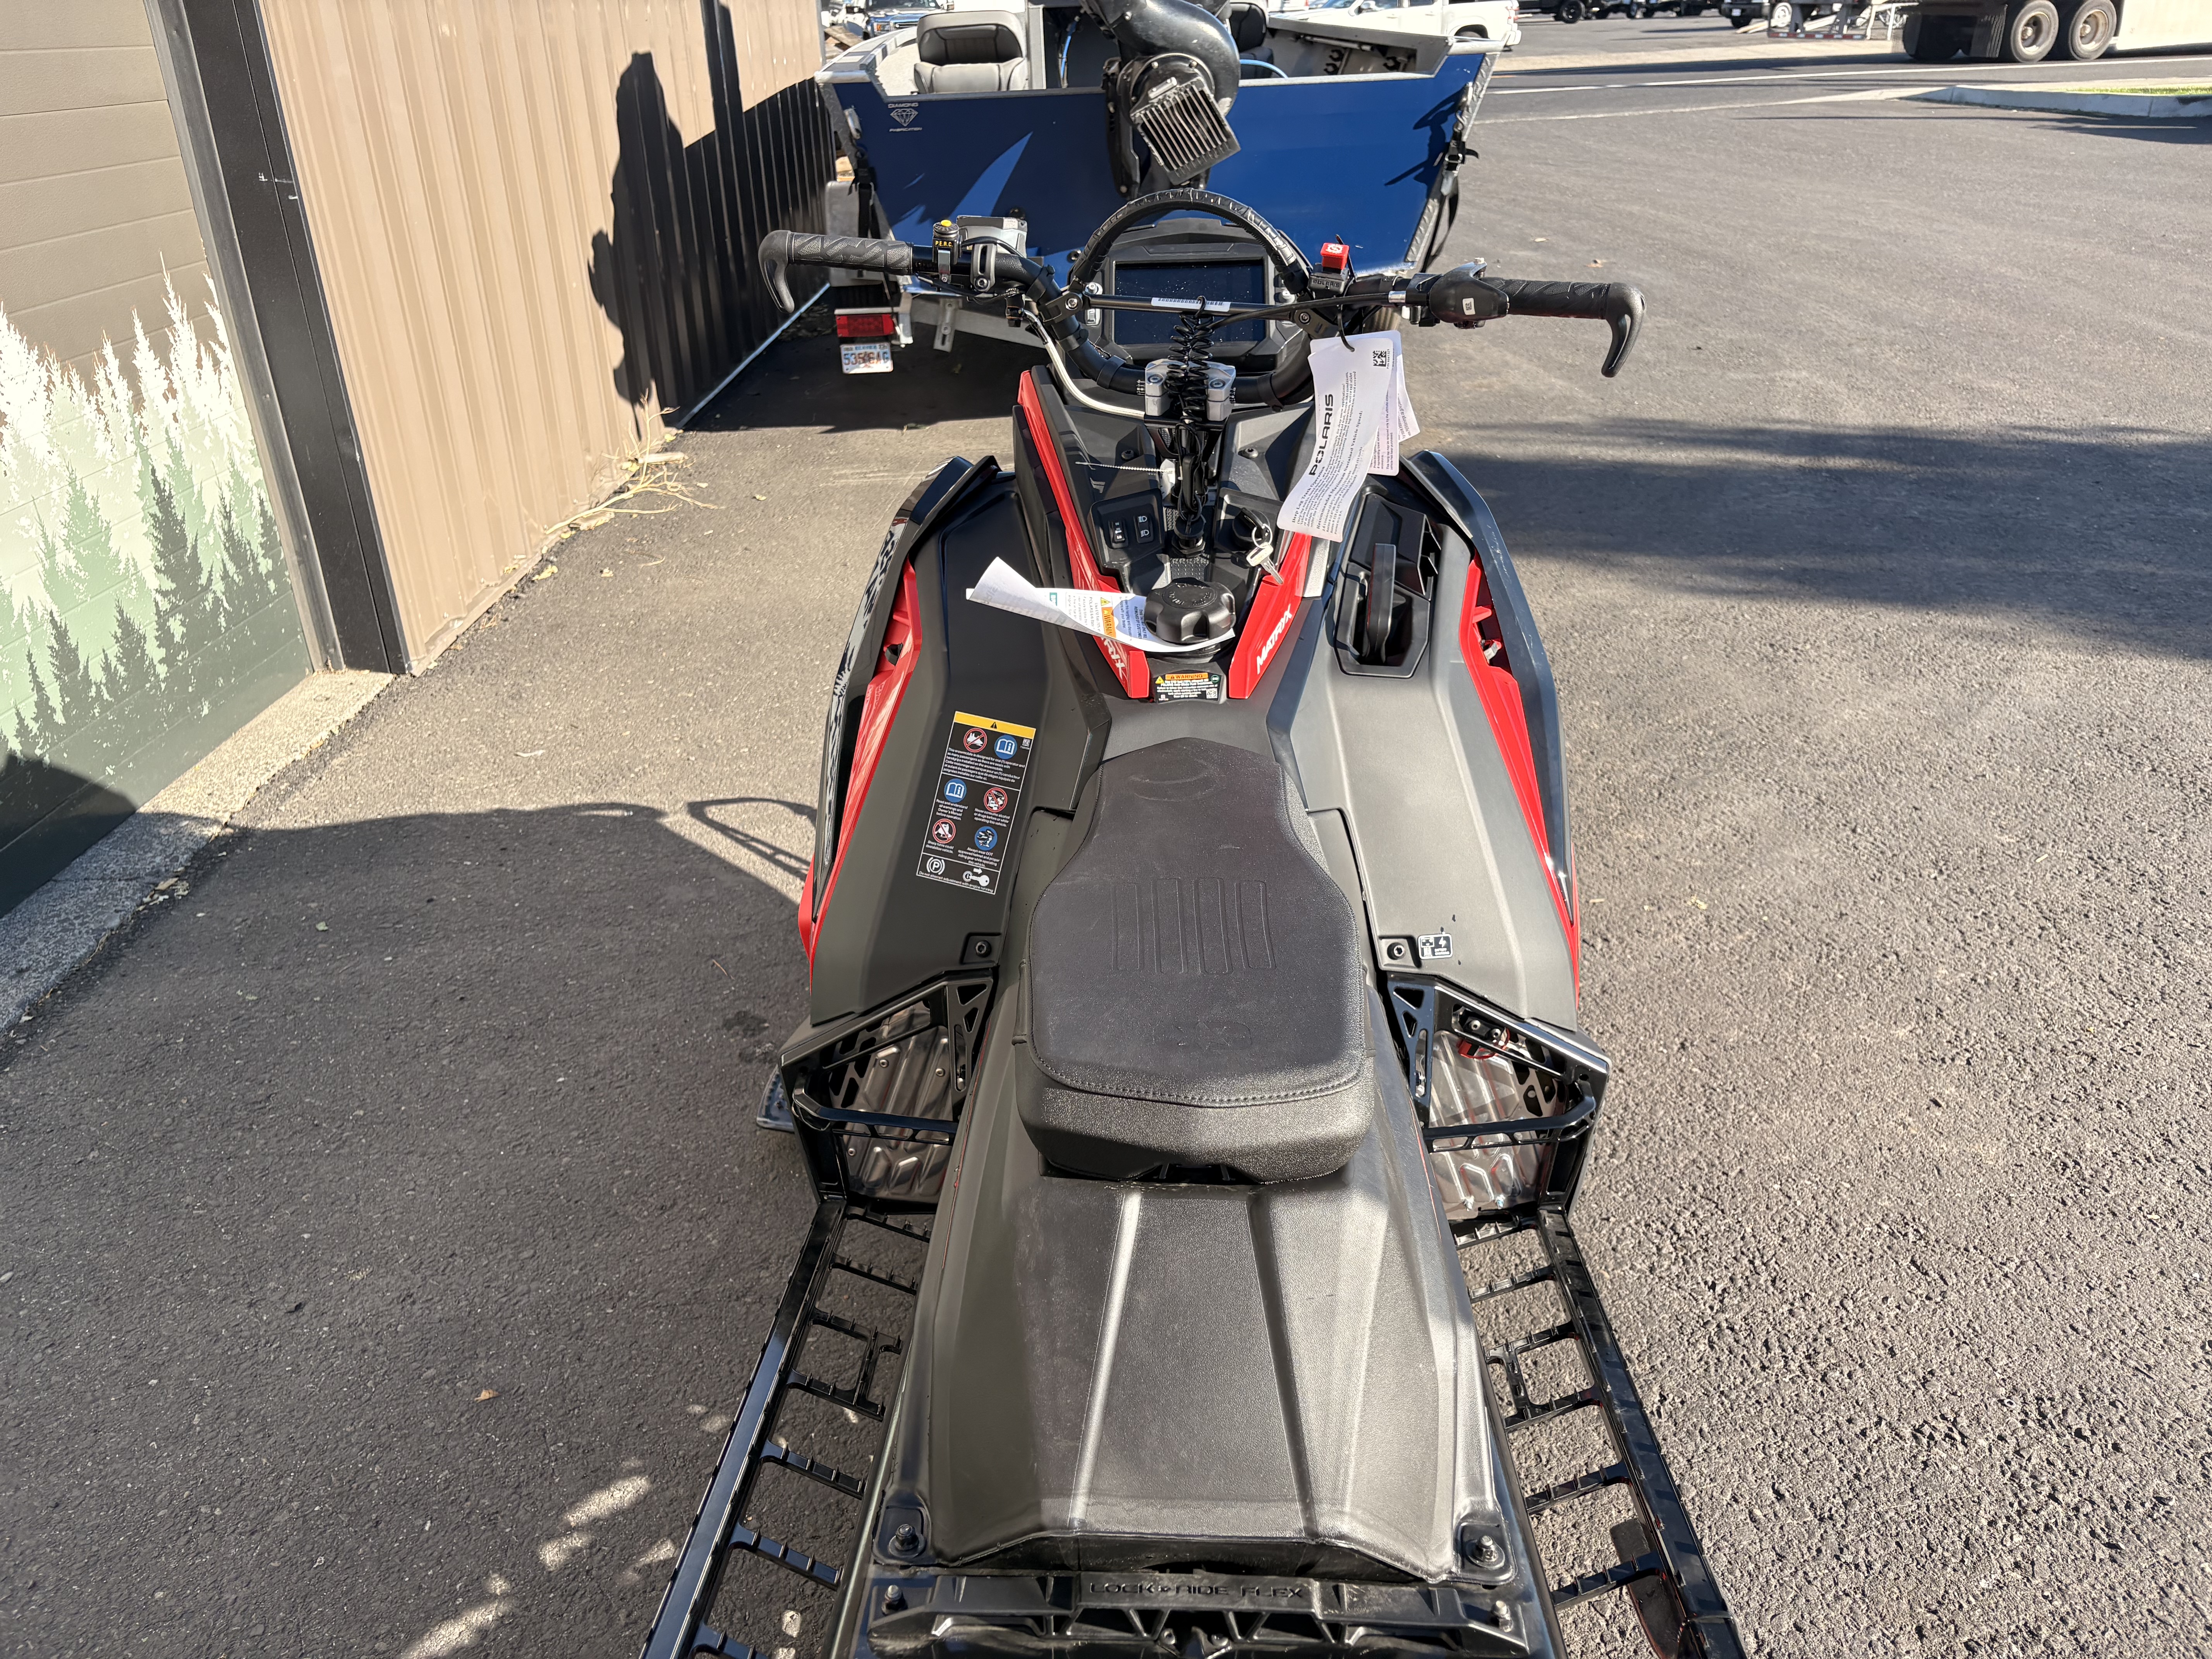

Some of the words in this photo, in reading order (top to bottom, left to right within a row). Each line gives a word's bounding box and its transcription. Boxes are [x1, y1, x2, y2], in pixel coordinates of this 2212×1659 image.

[1312, 279, 1340, 288] POLARIS
[1309, 394, 1333, 475] POLARIS
[1104, 614, 1113, 636] WARNIN
[1090, 1582, 1154, 1594] LOCK
[1175, 1584, 1229, 1595] RIDE
[1240, 1586, 1302, 1598] FLEX
